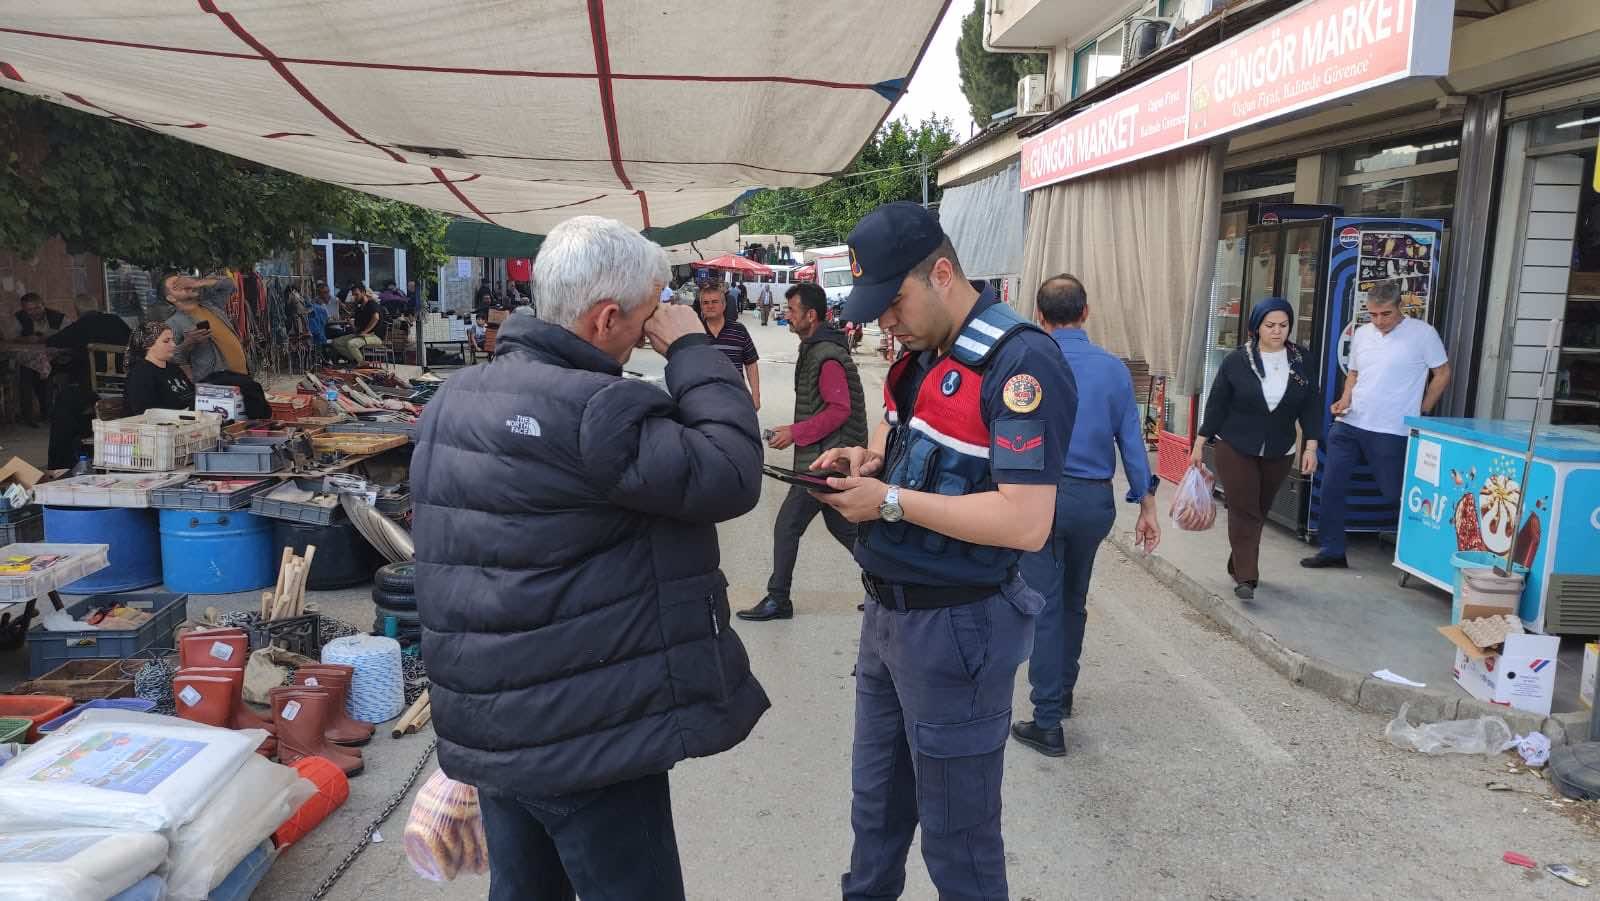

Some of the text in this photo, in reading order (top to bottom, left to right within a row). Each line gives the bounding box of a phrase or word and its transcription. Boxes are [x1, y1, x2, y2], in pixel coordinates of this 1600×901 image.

[1213, 28, 1298, 102] GÜNGÖR
[1030, 103, 1140, 179] GÜNGÖR MARKET
[505, 419, 529, 429] NORTH
[516, 414, 529, 423] THE
[511, 426, 529, 435] FACE
[1408, 485, 1448, 522] Golf
